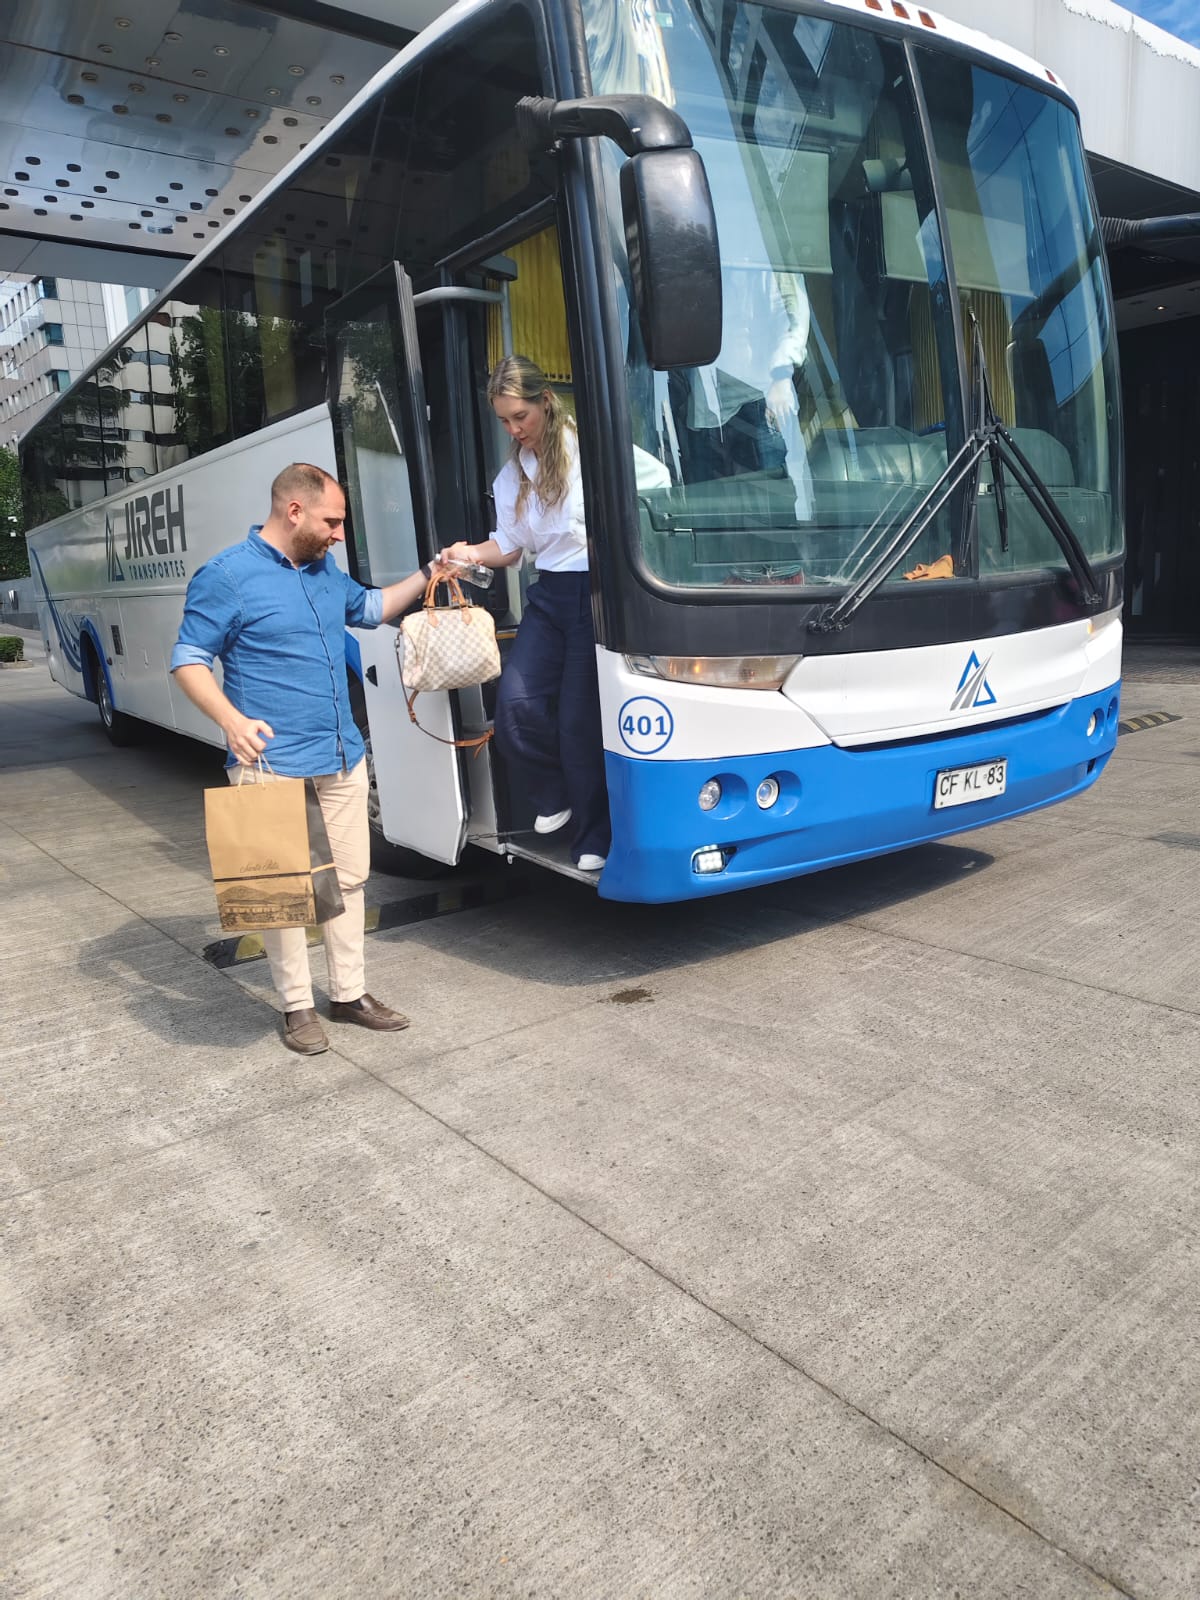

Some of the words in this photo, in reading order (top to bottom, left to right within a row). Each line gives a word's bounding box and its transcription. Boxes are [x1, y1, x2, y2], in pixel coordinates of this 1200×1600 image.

[124, 484, 187, 560] JIREH
[128, 560, 186, 580] TRANSPORTES
[622, 715, 668, 736] 401
[940, 773, 960, 796] CF
[963, 770, 982, 792] KL
[987, 765, 1004, 785] 83
